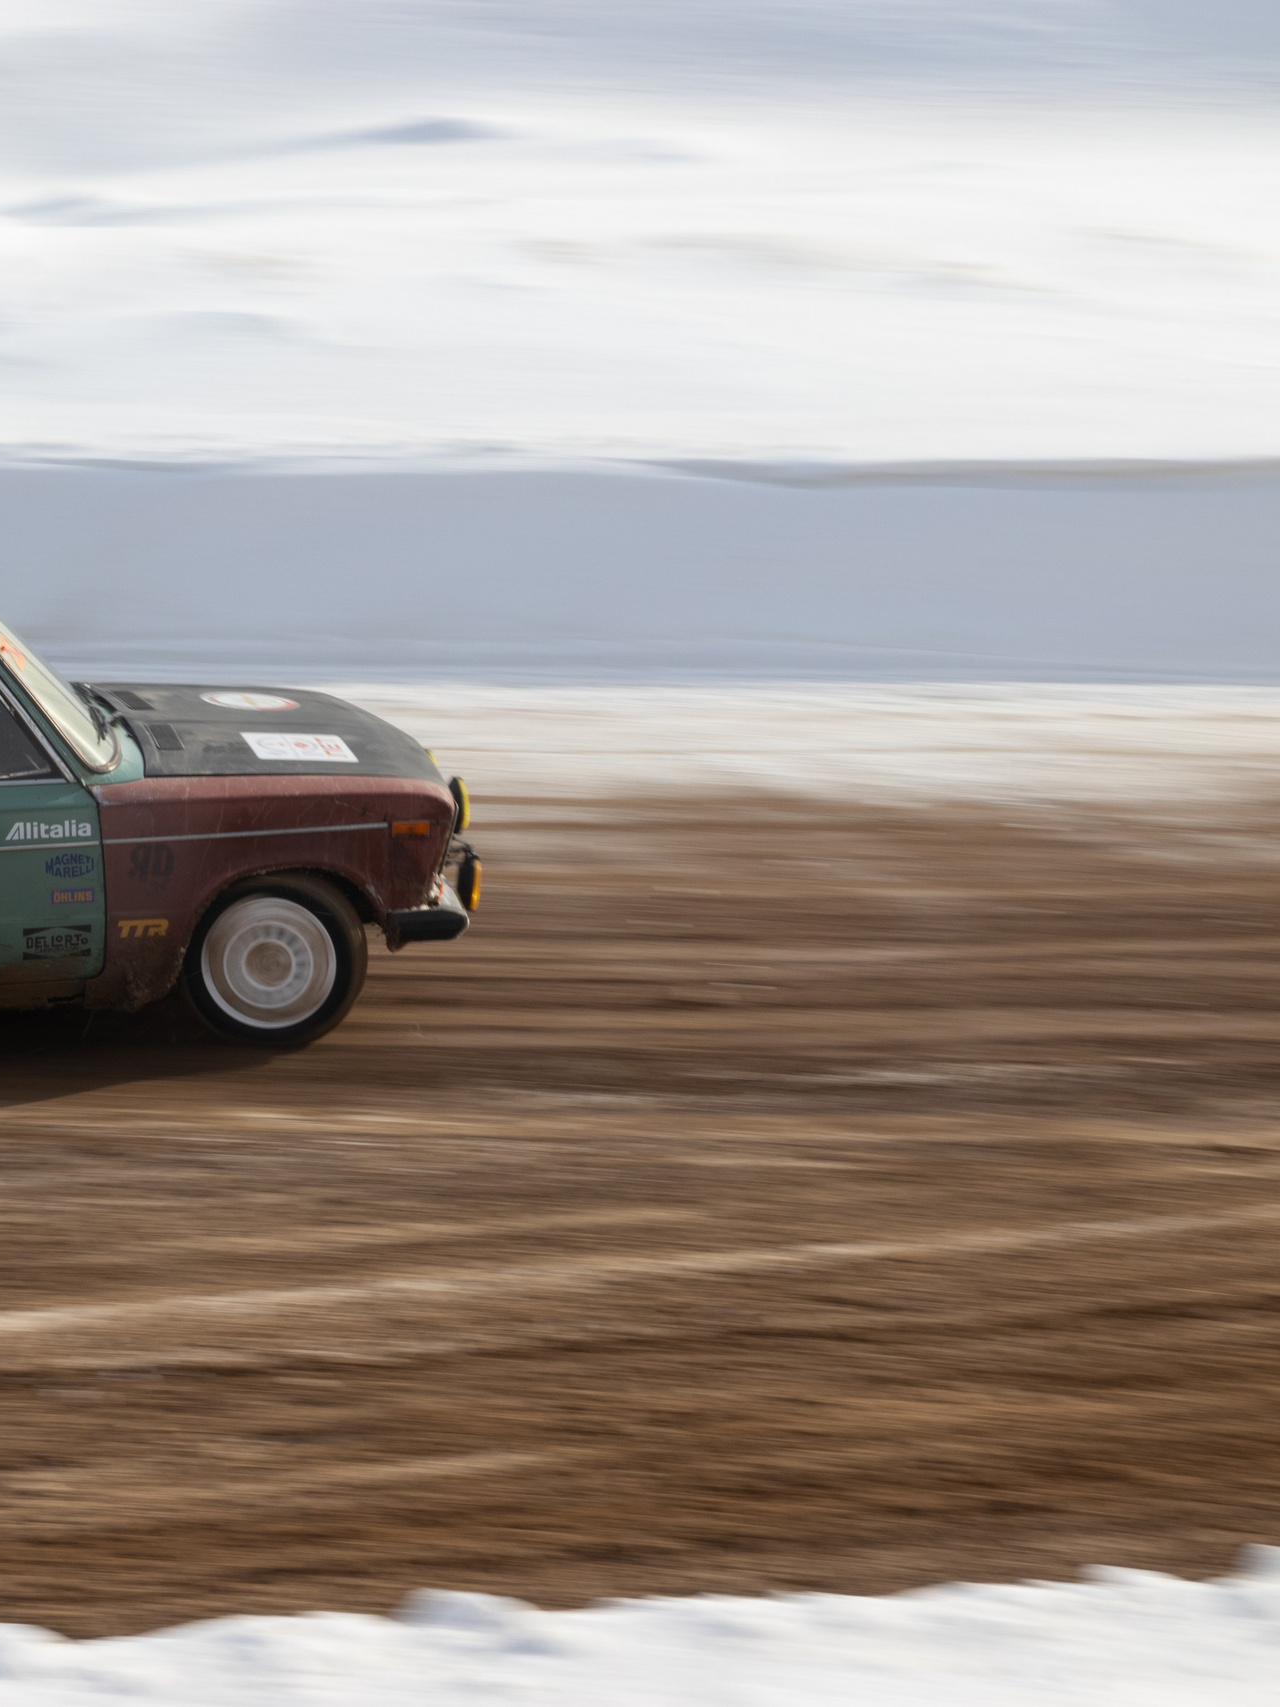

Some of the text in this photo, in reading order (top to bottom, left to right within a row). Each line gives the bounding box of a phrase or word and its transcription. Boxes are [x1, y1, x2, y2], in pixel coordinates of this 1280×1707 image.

[5, 820, 92, 841] Alitalia
[45, 853, 95, 870] MAGNETI
[45, 860, 95, 879] MARELLI
[53, 889, 93, 903] ÖHLINS
[117, 918, 169, 938] TTR
